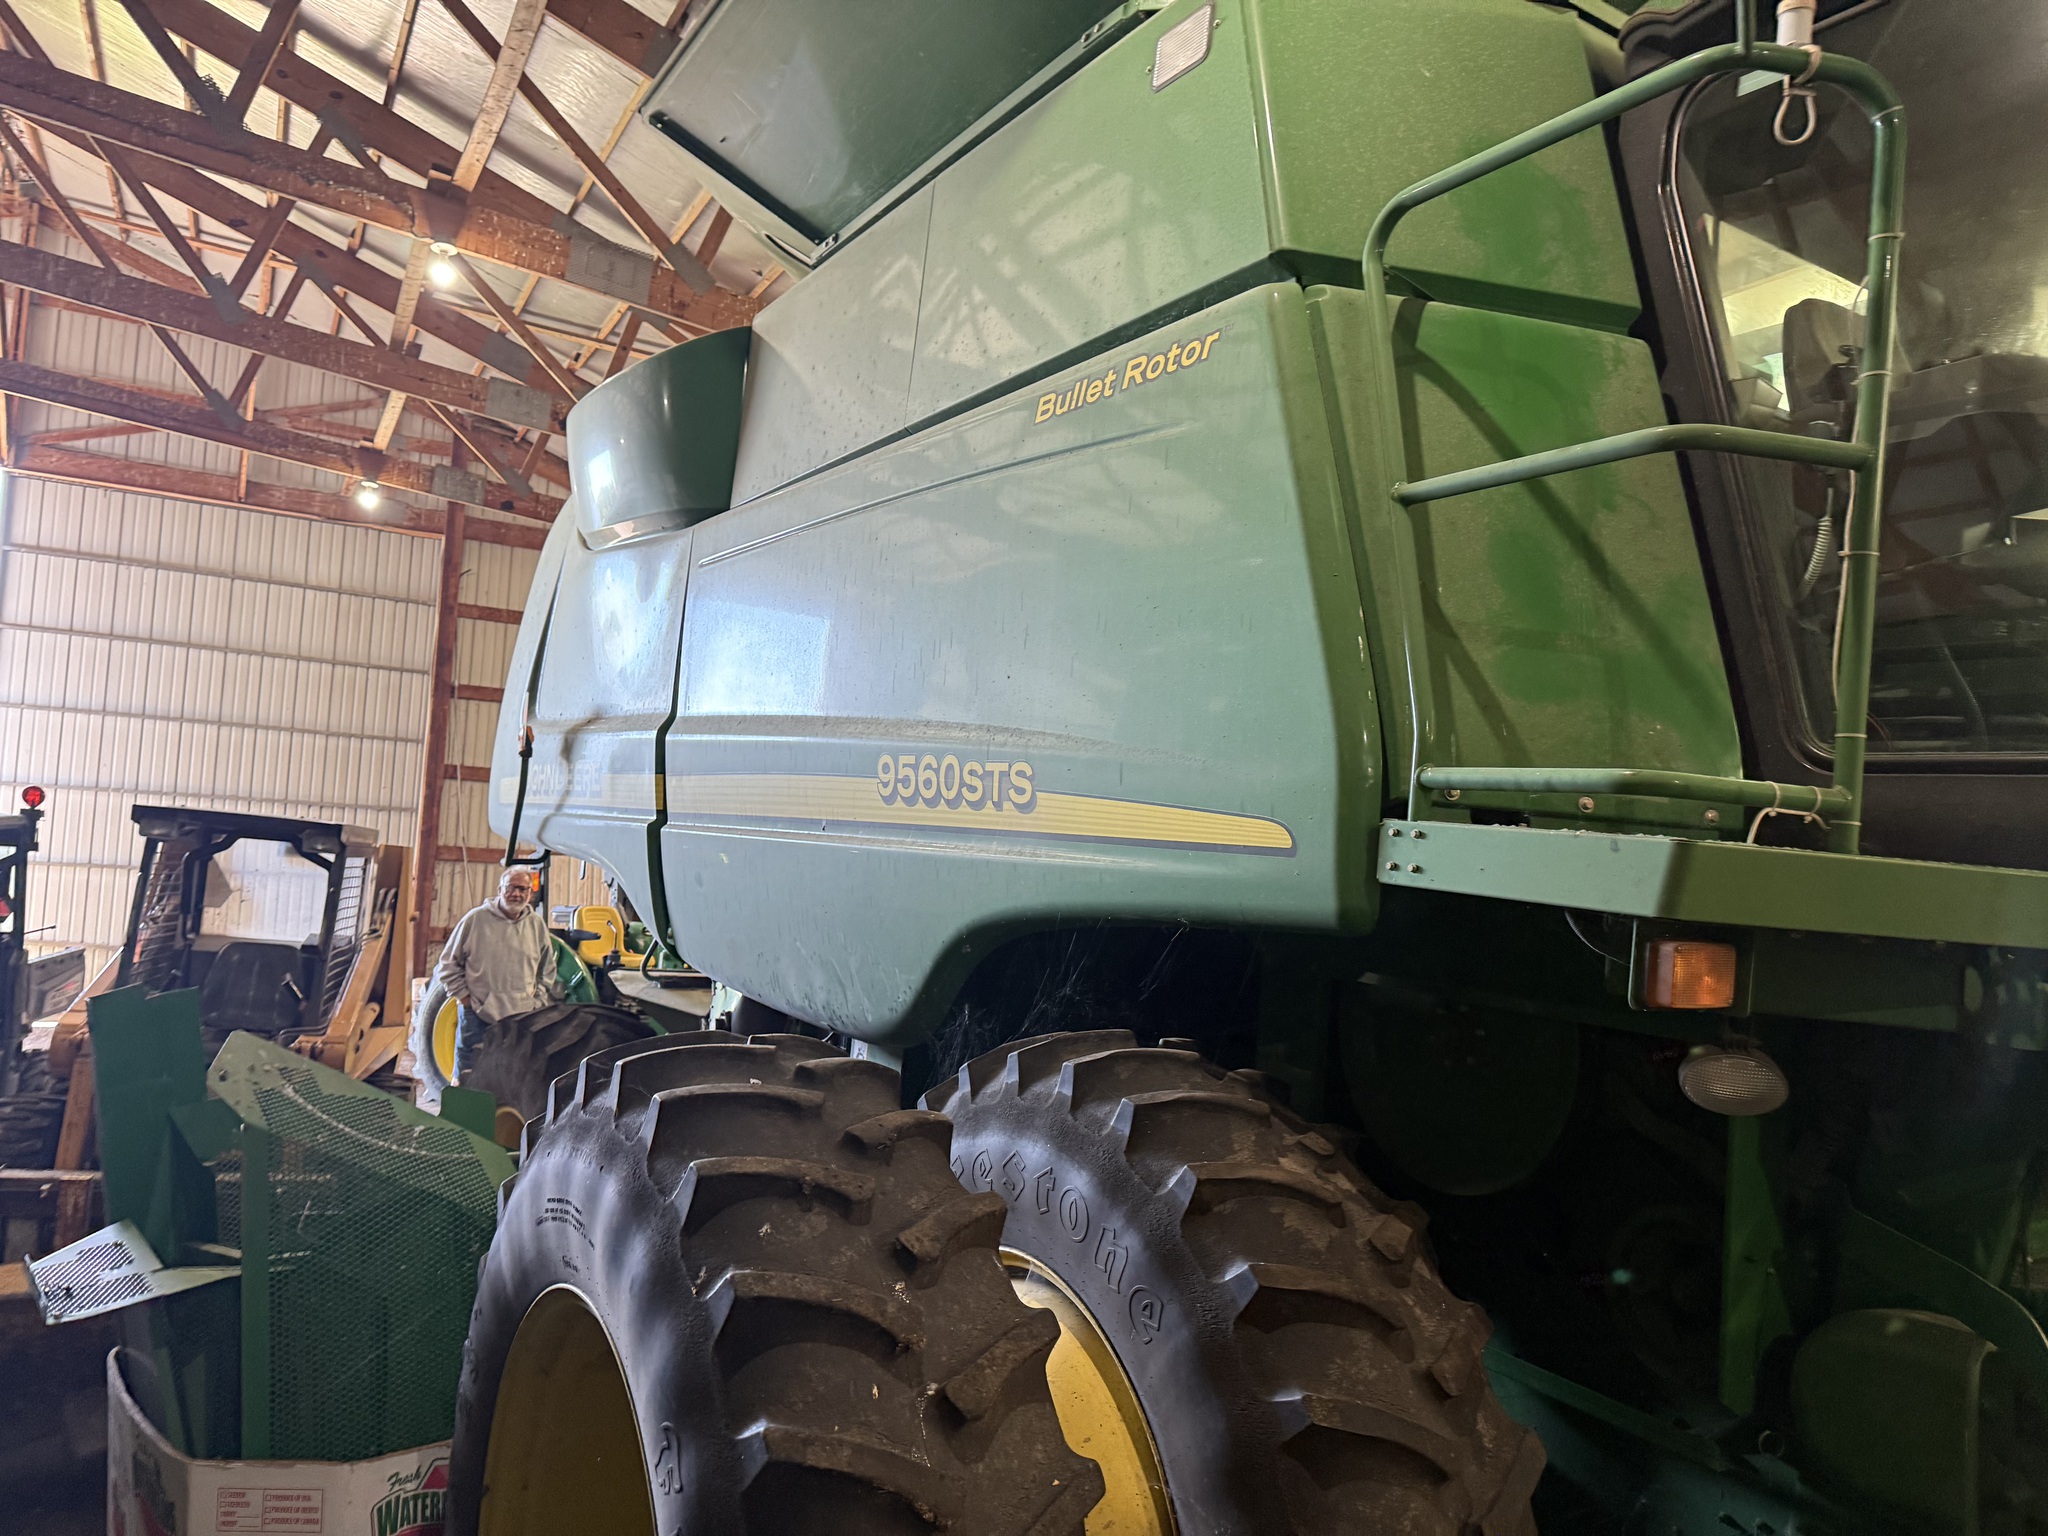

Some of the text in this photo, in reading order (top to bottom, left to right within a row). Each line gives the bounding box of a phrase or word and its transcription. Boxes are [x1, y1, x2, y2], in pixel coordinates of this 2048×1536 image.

[1034, 368, 1118, 425] Bullet
[1120, 330, 1222, 391] Rotor
[555, 760, 602, 794] DEERE
[877, 752, 1036, 812] 9560STS
[950, 1147, 1165, 1346] estone
[386, 1464, 422, 1492] Fresh
